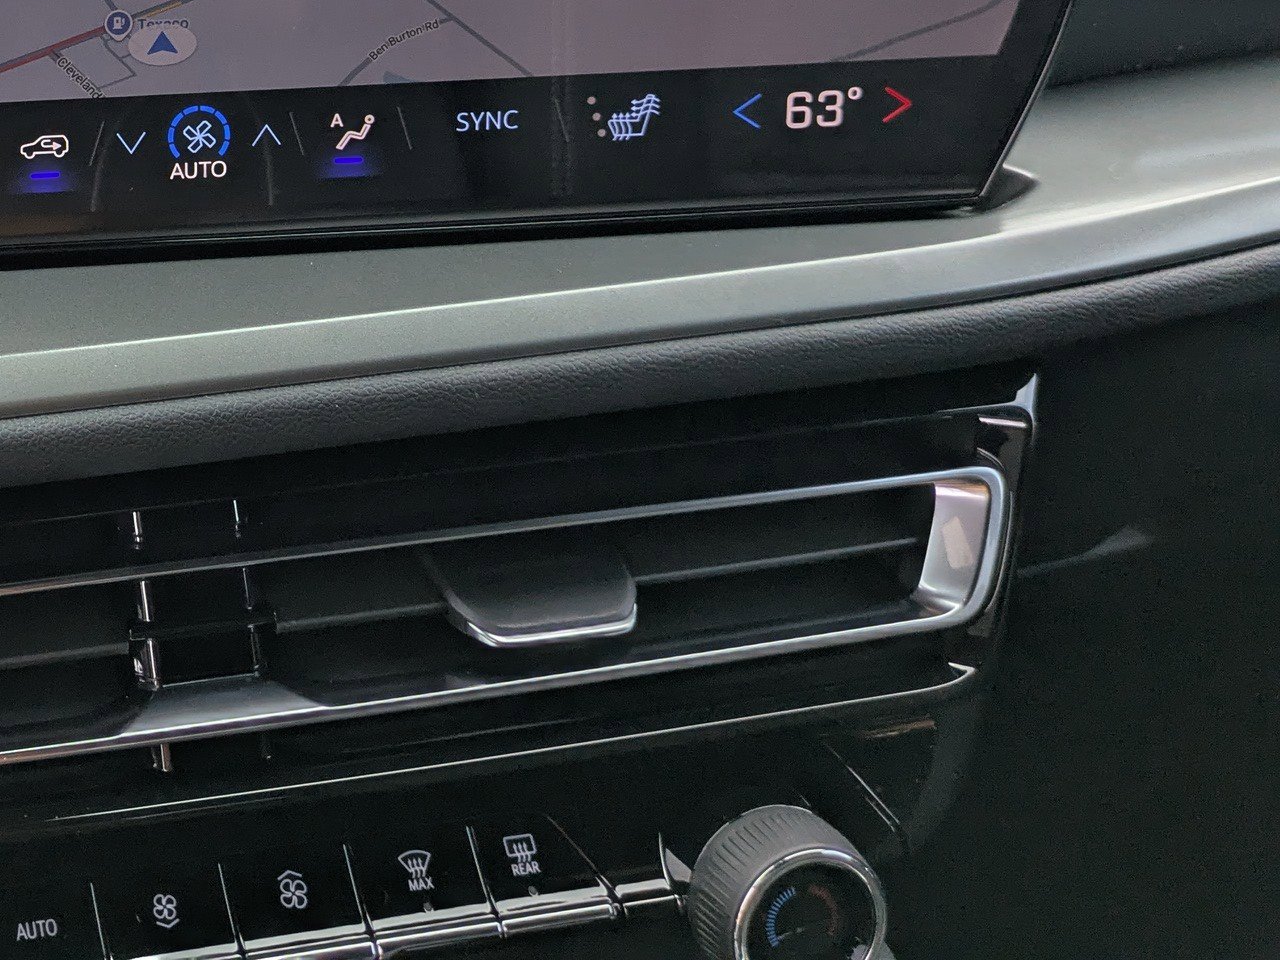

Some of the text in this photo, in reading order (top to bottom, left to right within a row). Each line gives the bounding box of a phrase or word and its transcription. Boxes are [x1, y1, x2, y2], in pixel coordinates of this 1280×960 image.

[369, 19, 440, 62] Ben Burton Rd
[330, 113, 343, 128] A
[455, 109, 519, 132] SYNC
[169, 160, 228, 181] AUTO
[511, 861, 541, 876] REAR
[408, 877, 435, 892] MAX
[16, 918, 58, 942] AUTO
